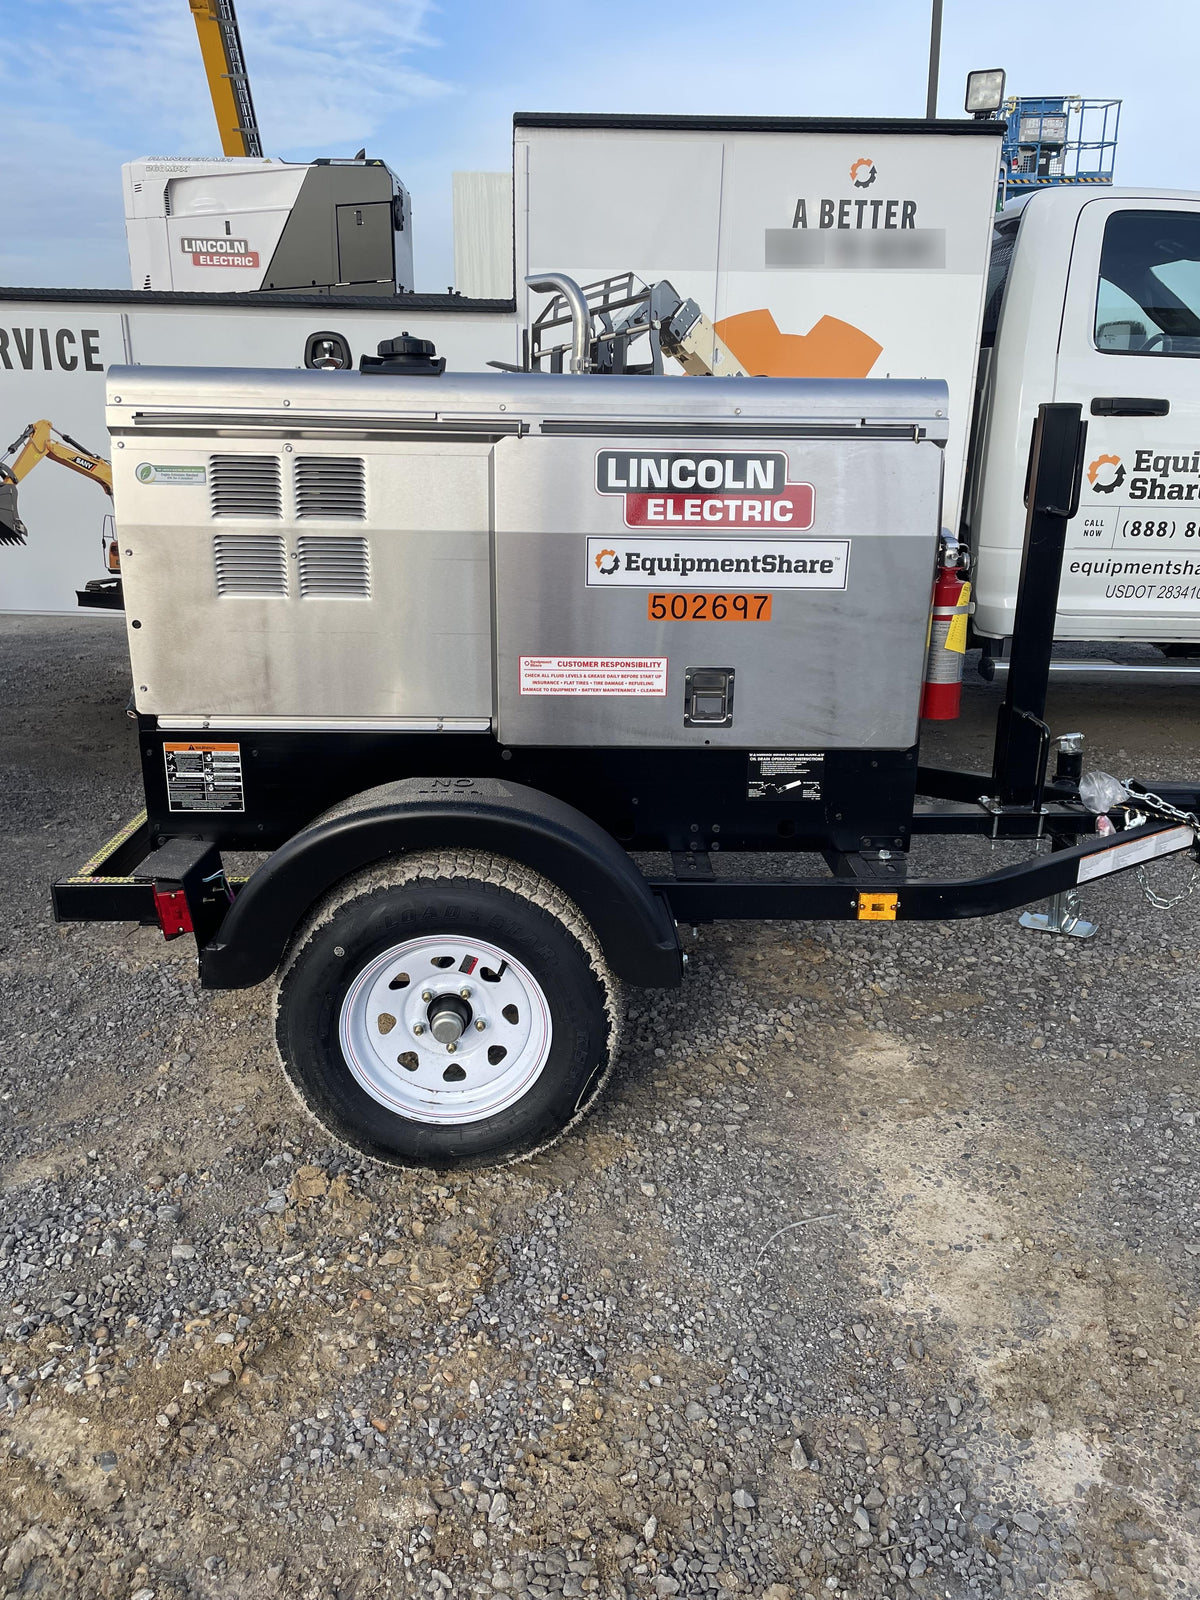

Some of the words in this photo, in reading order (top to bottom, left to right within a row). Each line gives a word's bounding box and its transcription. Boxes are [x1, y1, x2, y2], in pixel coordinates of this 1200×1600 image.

[792, 199, 808, 228] A
[819, 199, 917, 229] BETTER
[184, 240, 245, 254] LINCOLN
[200, 255, 253, 266] ELECTRIC
[75, 457, 93, 470] SANY
[607, 458, 775, 489] LINCOLN
[1133, 450, 1200, 478] Equi
[1129, 478, 1200, 500] Shar
[647, 498, 793, 522] ELECTRIC
[1122, 520, 1176, 538] (888)
[1184, 521, 1200, 538] 8
[1105, 585, 1156, 599] USDOT
[651, 595, 769, 619] 502697
[431, 779, 474, 787] NO
